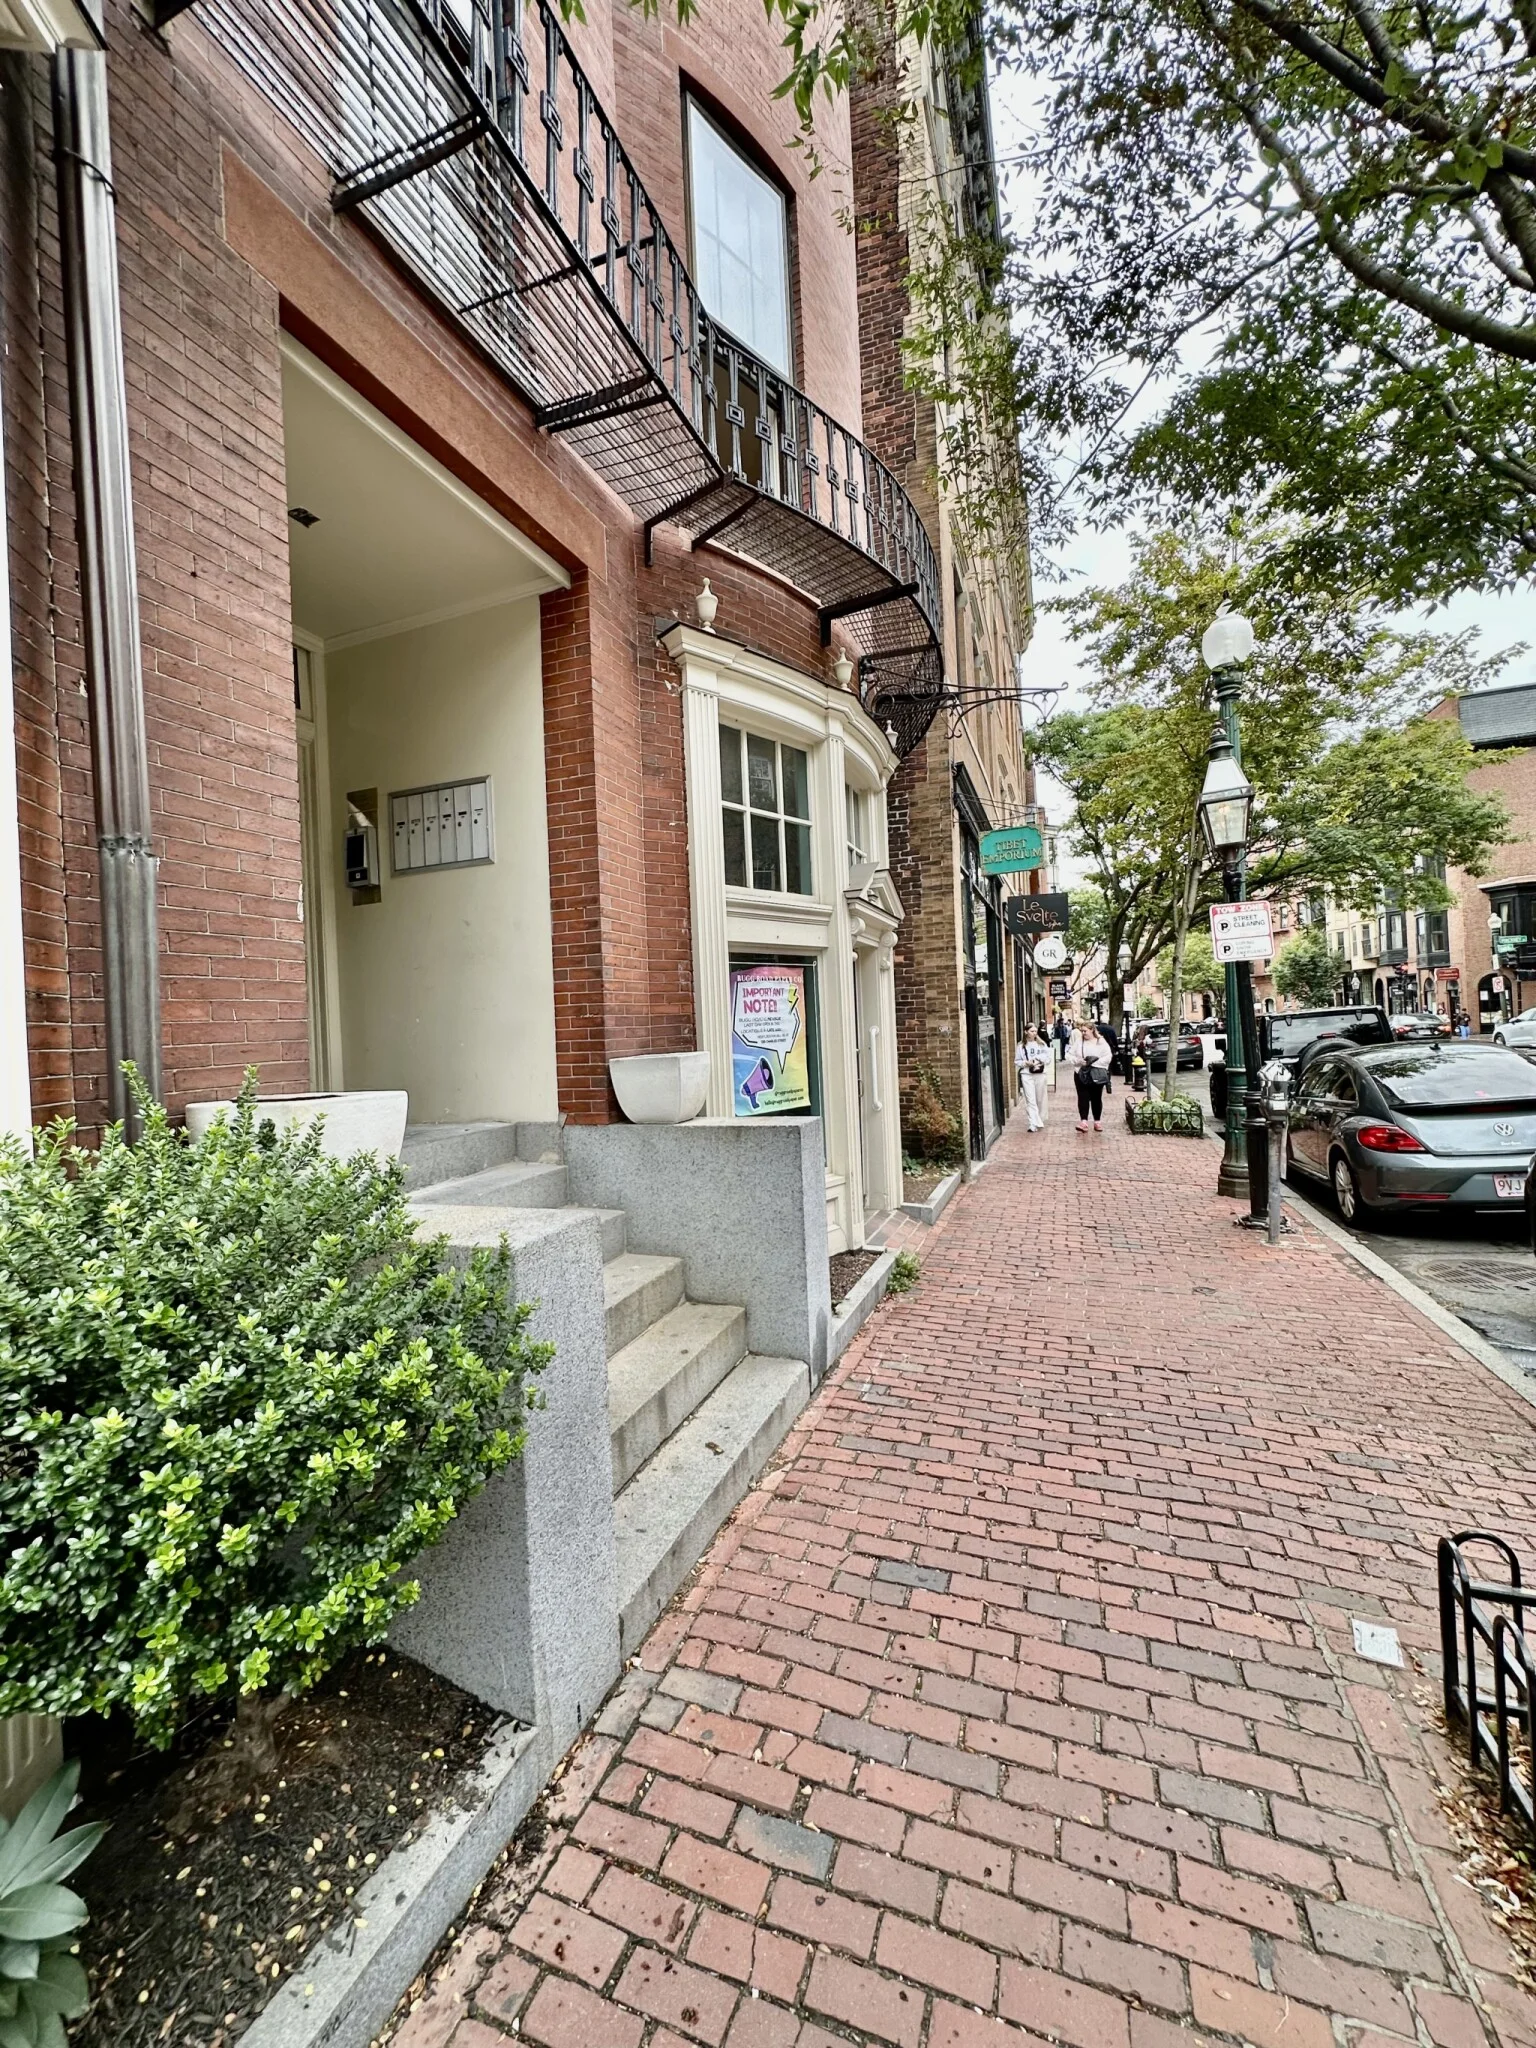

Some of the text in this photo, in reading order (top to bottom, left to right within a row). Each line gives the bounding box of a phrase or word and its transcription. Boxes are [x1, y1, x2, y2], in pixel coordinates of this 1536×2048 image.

[995, 839, 1027, 852] TIBET
[982, 848, 1041, 865] EMPORIUM
[1022, 899, 1040, 911] Le
[1216, 903, 1265, 914] TOW ZONE
[1016, 908, 1059, 927] Svelte
[1233, 920, 1266, 928] CLEANING
[1042, 949, 1057, 959] GR
[742, 987, 785, 998] IMPORTANT
[743, 999, 778, 1014] NOTE!
